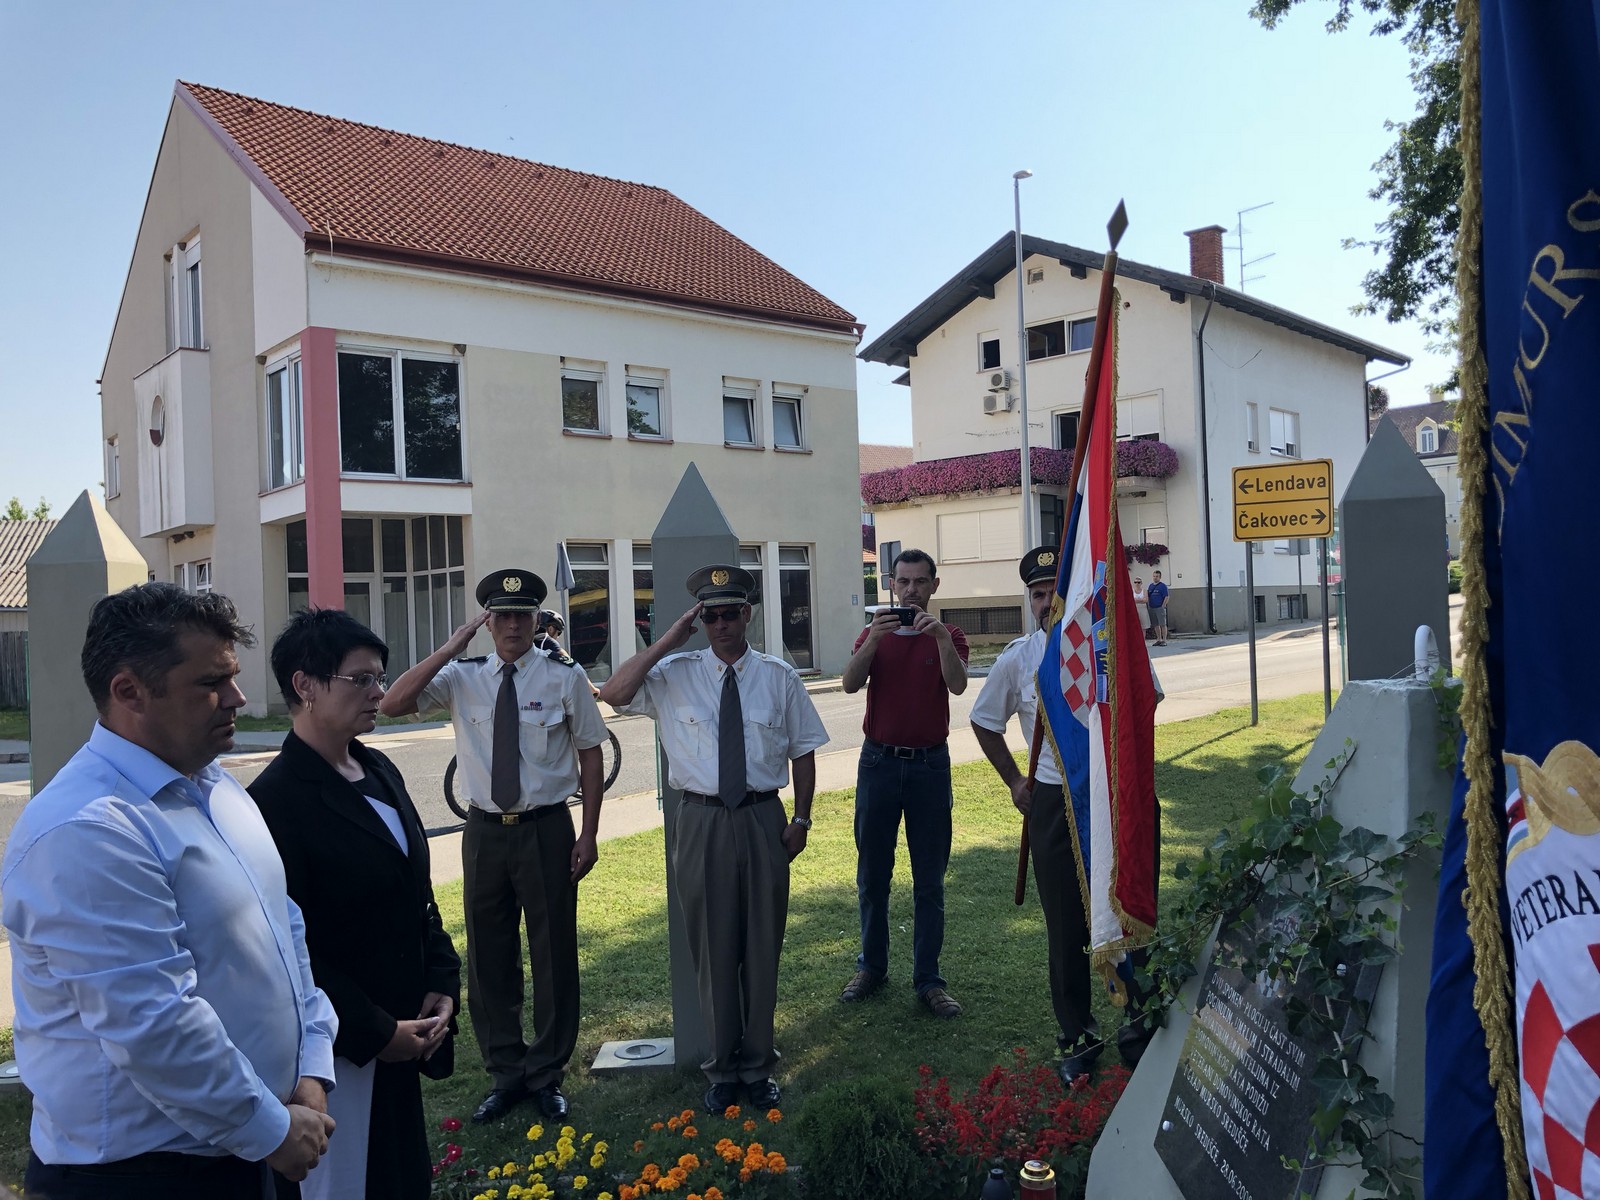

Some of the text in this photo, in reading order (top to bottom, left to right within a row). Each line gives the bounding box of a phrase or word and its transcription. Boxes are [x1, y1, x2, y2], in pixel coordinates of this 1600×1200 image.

[1256, 475, 1326, 493] Lendava
[1239, 511, 1308, 529] Čakovec
[1512, 869, 1600, 950] VETERA
[1212, 972, 1223, 990] OVU
[1262, 1018, 1270, 1033] U
[1286, 1041, 1305, 1067] SVIM
[1261, 1044, 1300, 1091] STRADALIM
[1200, 1084, 1221, 1118] MURSKO
[1229, 1064, 1245, 1090] RATA
[1245, 1079, 1269, 1116] PODIŽU
[1270, 1081, 1278, 1098] IZ
[1174, 1095, 1193, 1127] MURSKO
[1213, 1073, 1251, 1127] DOMOVINSKOG
[1251, 1119, 1271, 1150] RATA
